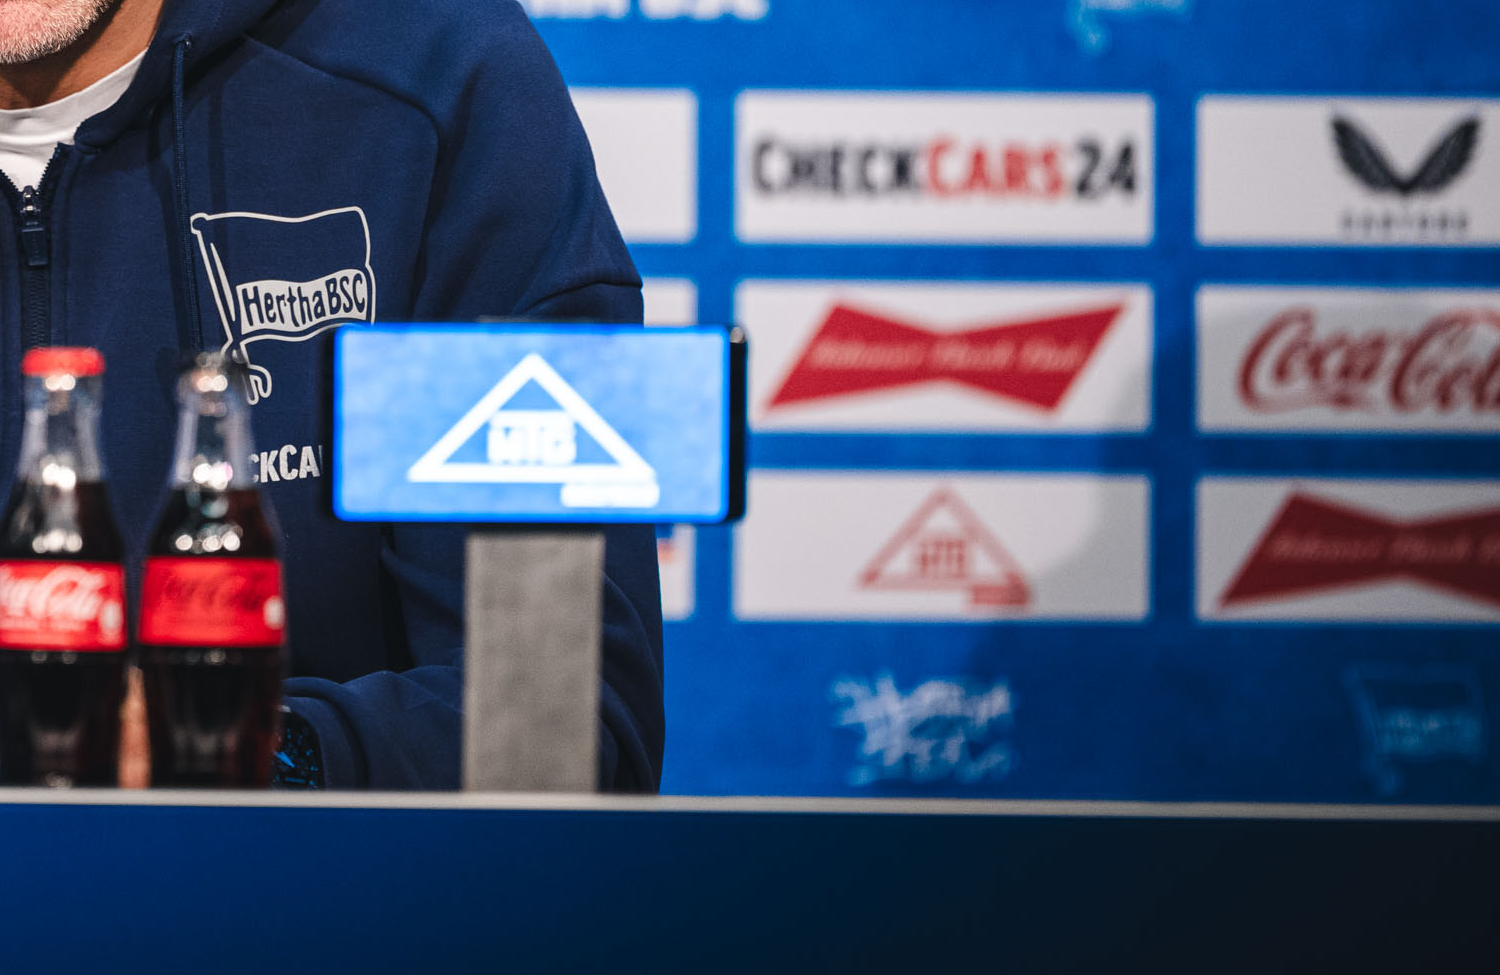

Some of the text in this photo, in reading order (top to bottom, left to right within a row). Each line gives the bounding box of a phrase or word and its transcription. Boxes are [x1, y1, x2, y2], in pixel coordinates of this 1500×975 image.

[750, 136, 1141, 201] CHECKCARS24
[241, 273, 366, 327] Hertha BSC
